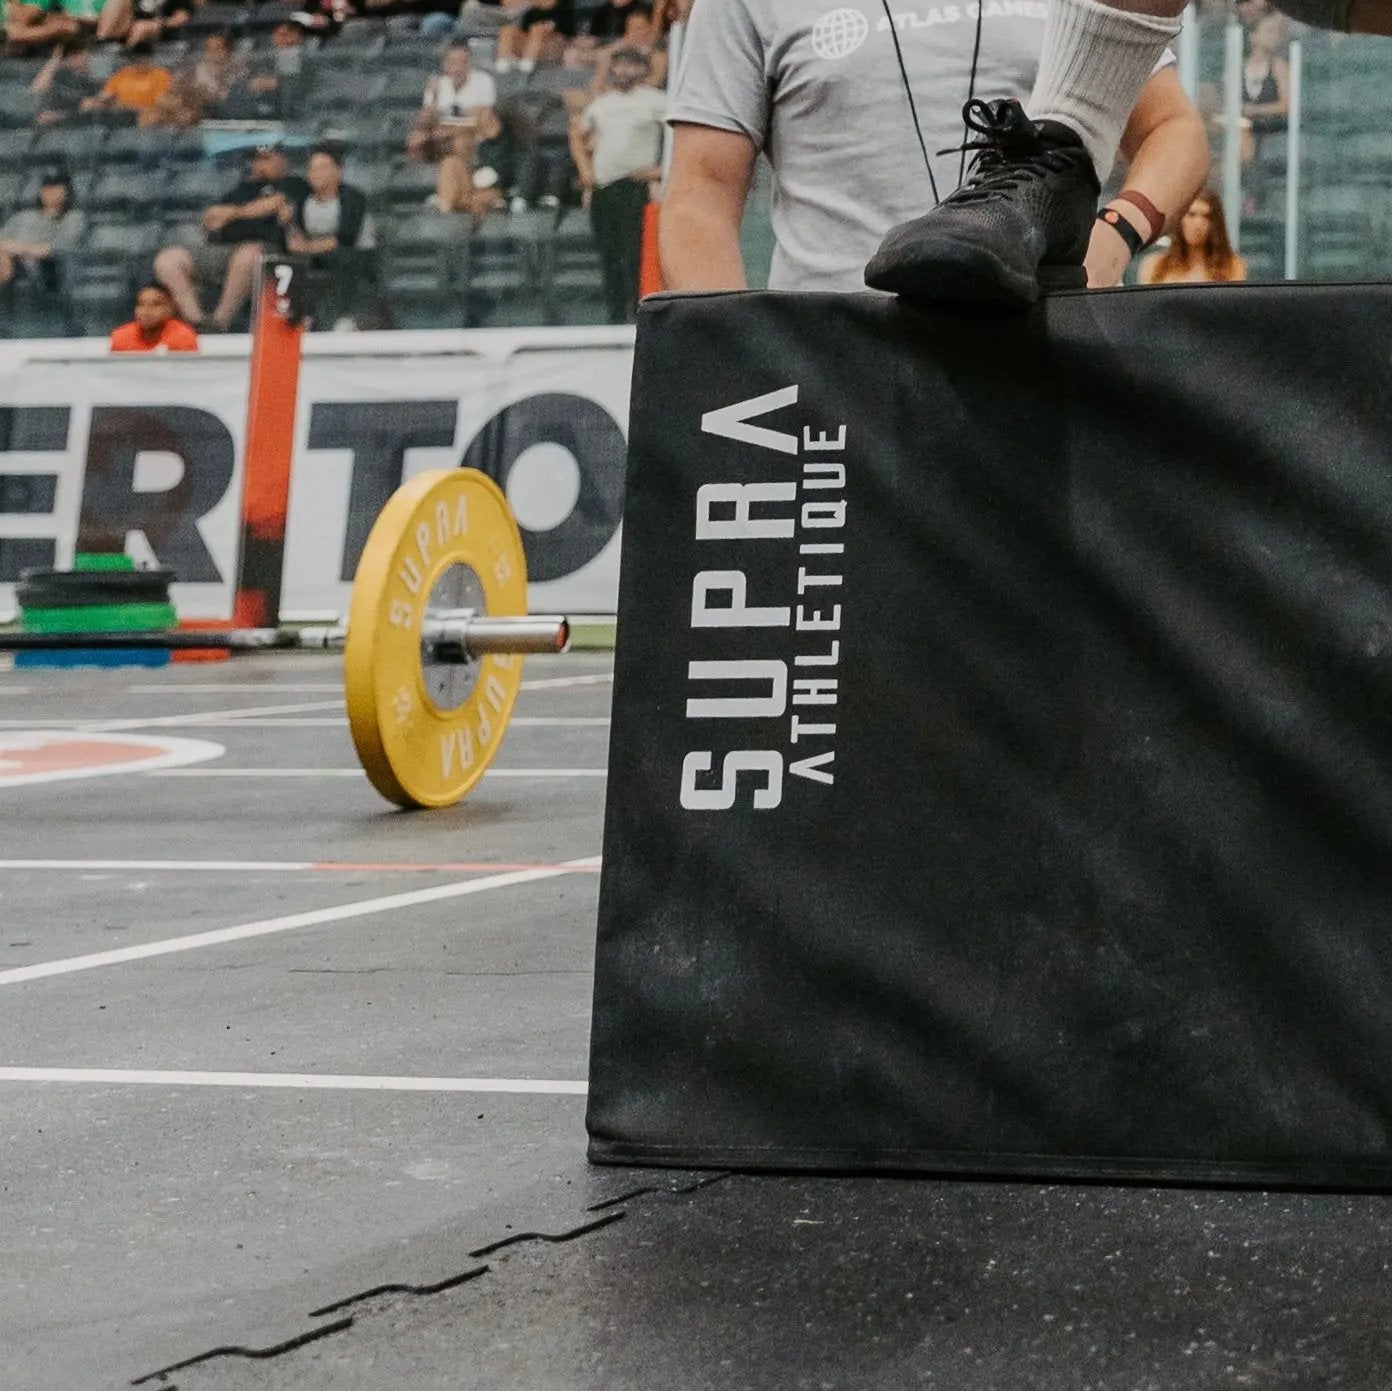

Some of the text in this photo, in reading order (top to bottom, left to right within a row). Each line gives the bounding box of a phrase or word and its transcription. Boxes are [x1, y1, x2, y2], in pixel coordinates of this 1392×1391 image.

[306, 393, 628, 583] TO
[389, 494, 469, 630] SUPRA
[680, 384, 799, 810] SUPRA
[789, 424, 847, 785] ATHLETIQUE
